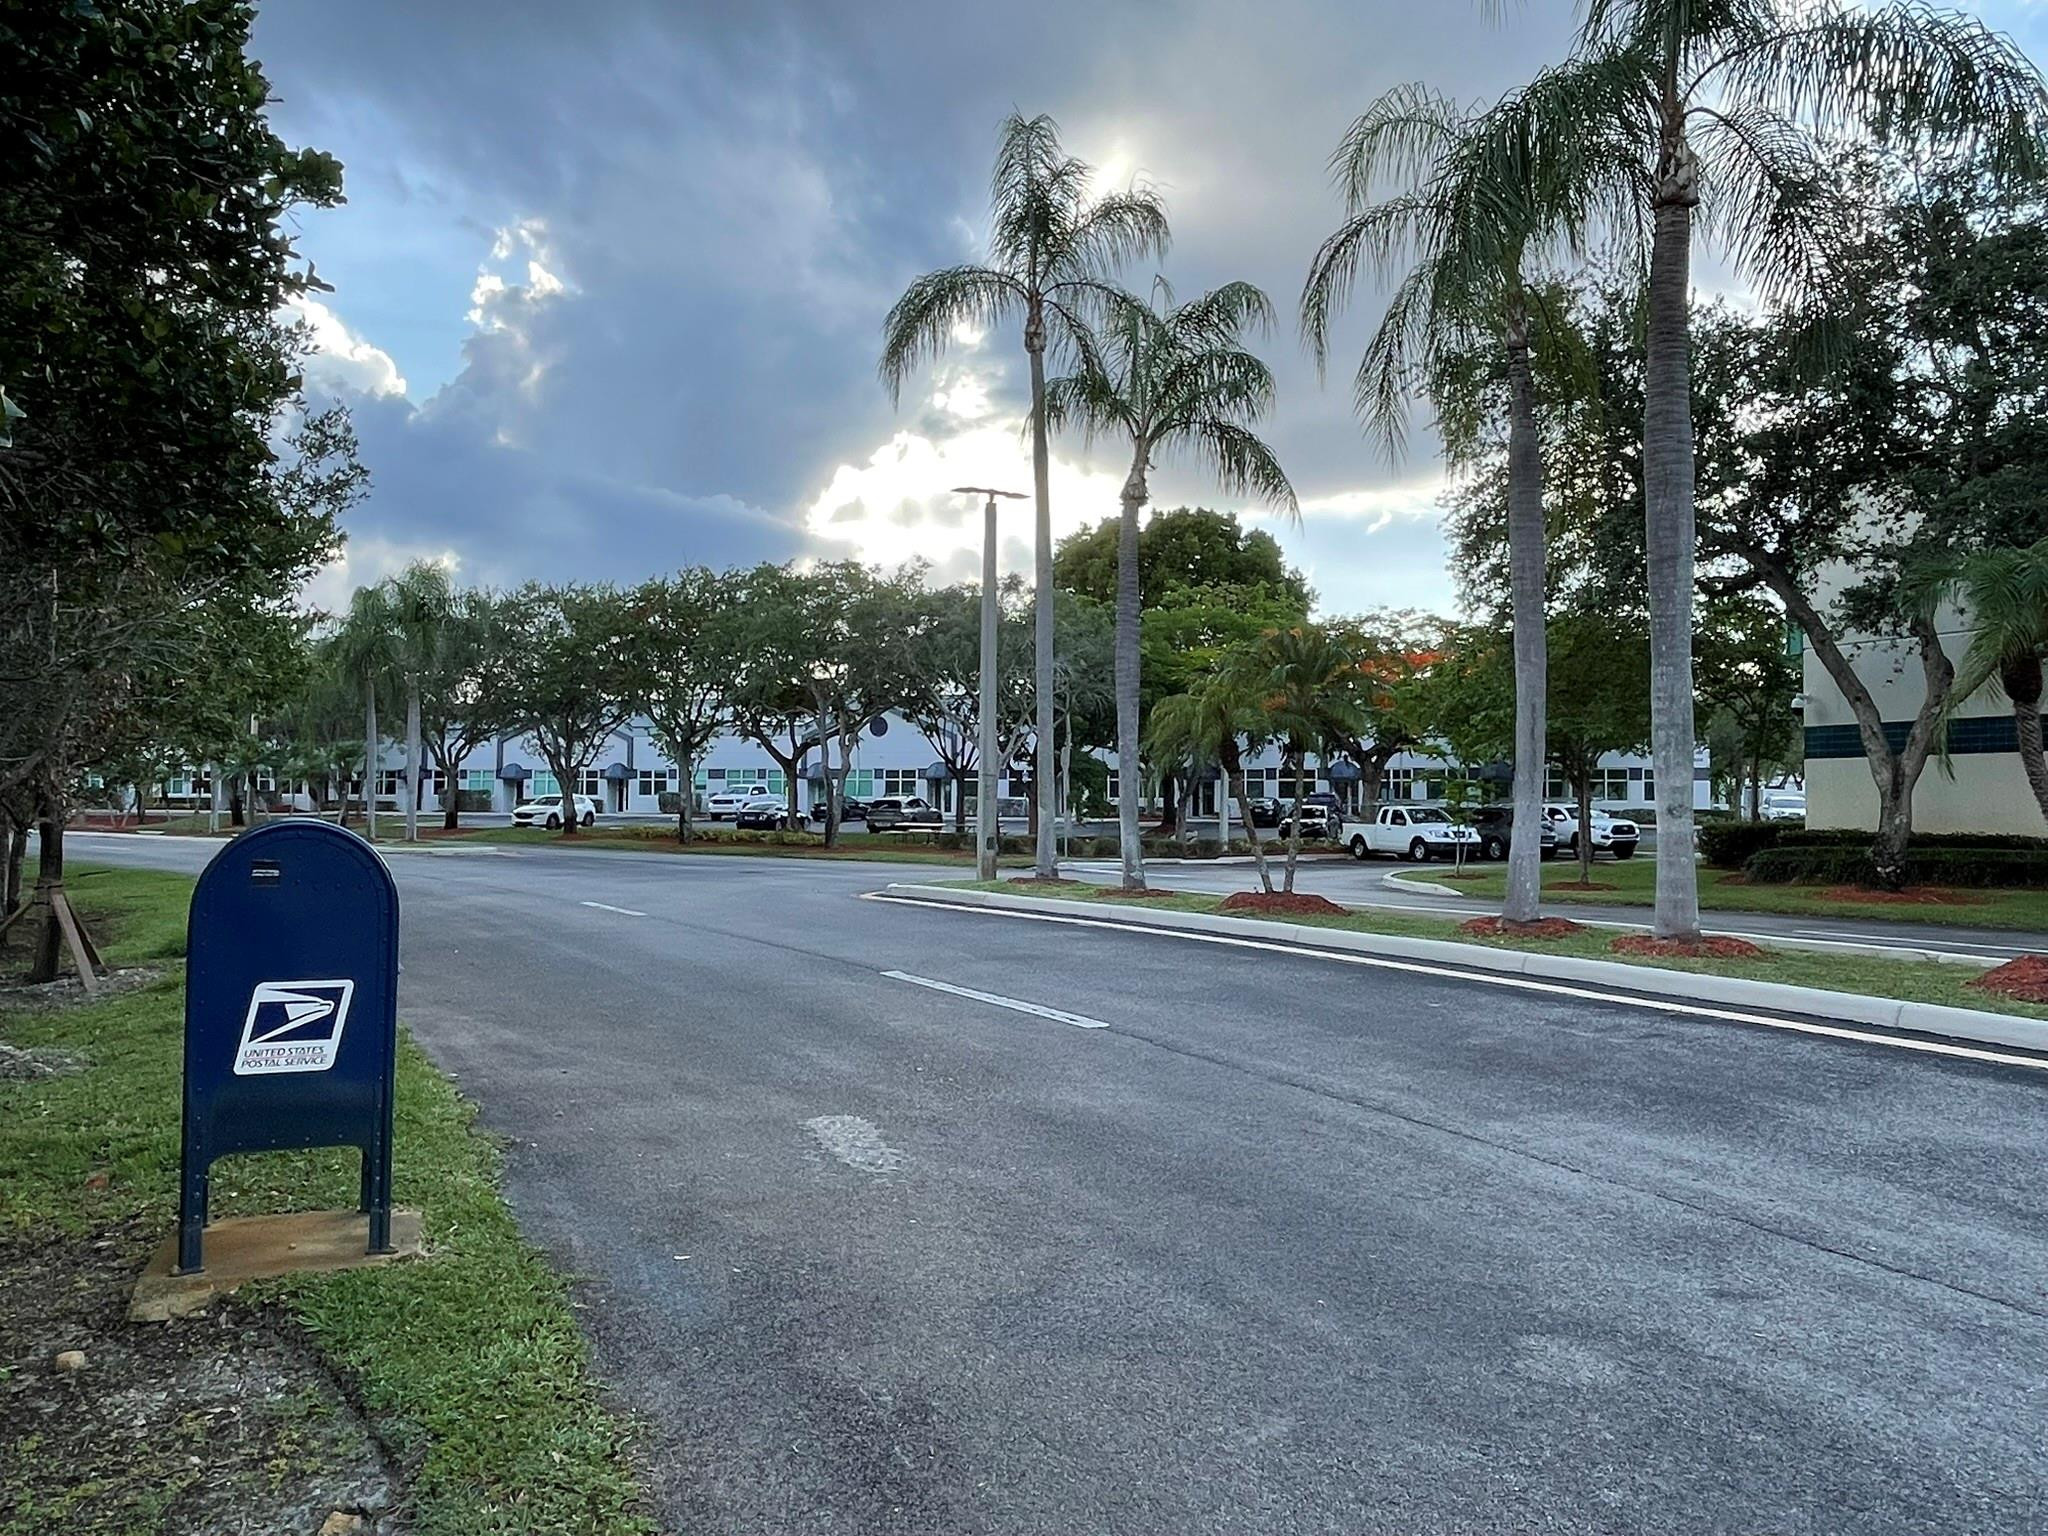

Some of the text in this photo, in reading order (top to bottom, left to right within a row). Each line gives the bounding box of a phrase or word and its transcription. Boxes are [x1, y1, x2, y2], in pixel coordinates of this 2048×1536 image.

[244, 1046, 325, 1058] UNITED STATES
[241, 1057, 327, 1068] POSTAL SERVICE
